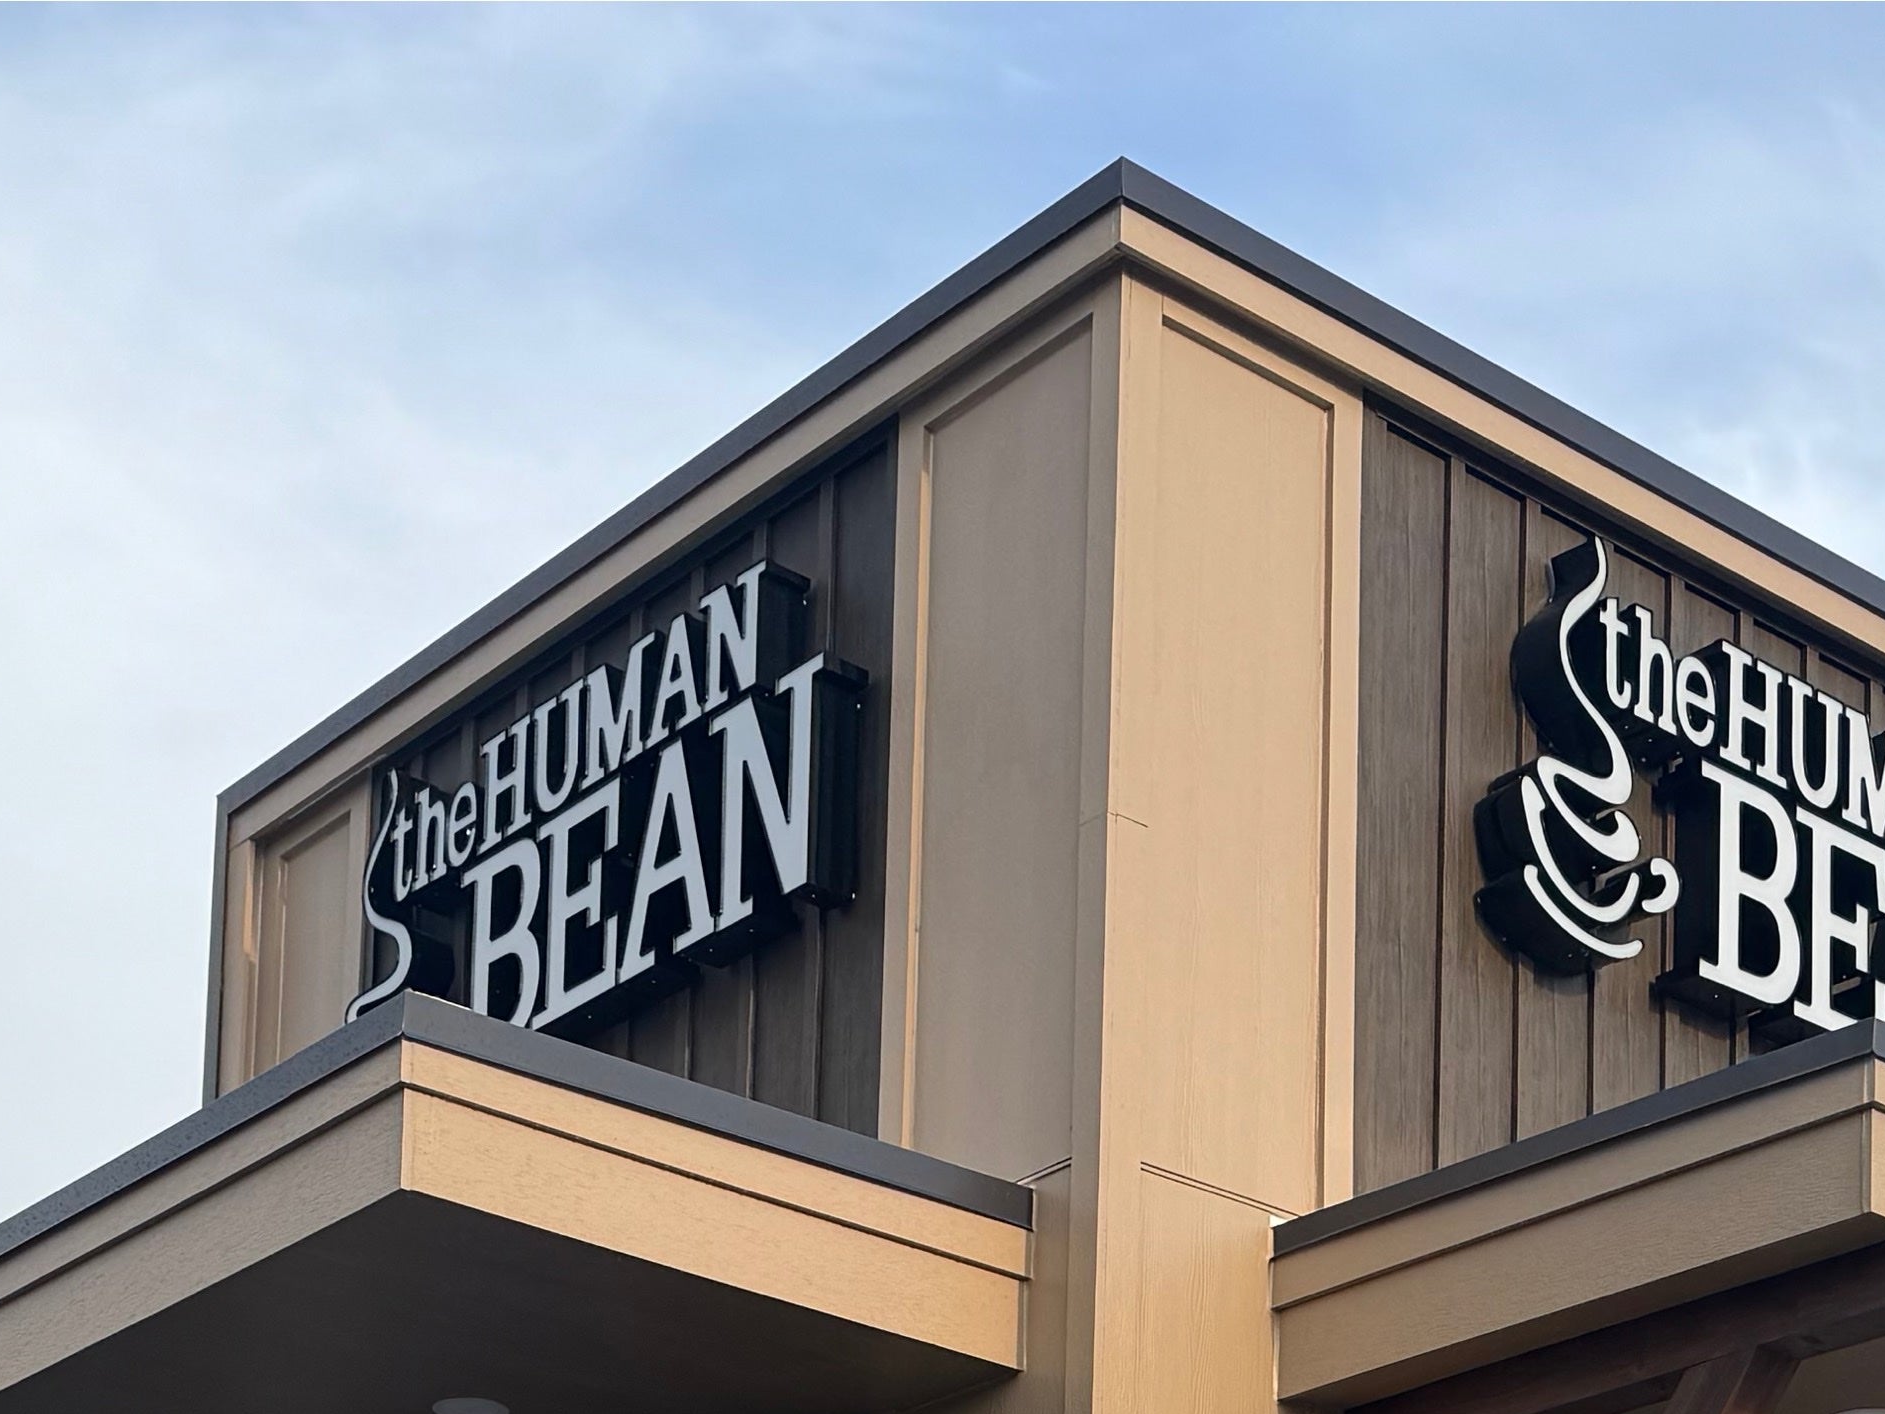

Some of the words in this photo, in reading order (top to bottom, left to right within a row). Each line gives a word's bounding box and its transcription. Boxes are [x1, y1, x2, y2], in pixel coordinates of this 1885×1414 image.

[391, 781, 478, 902] the
[477, 559, 768, 855] HUMAN
[460, 651, 825, 1031] BEAN
[1600, 597, 1715, 748] the
